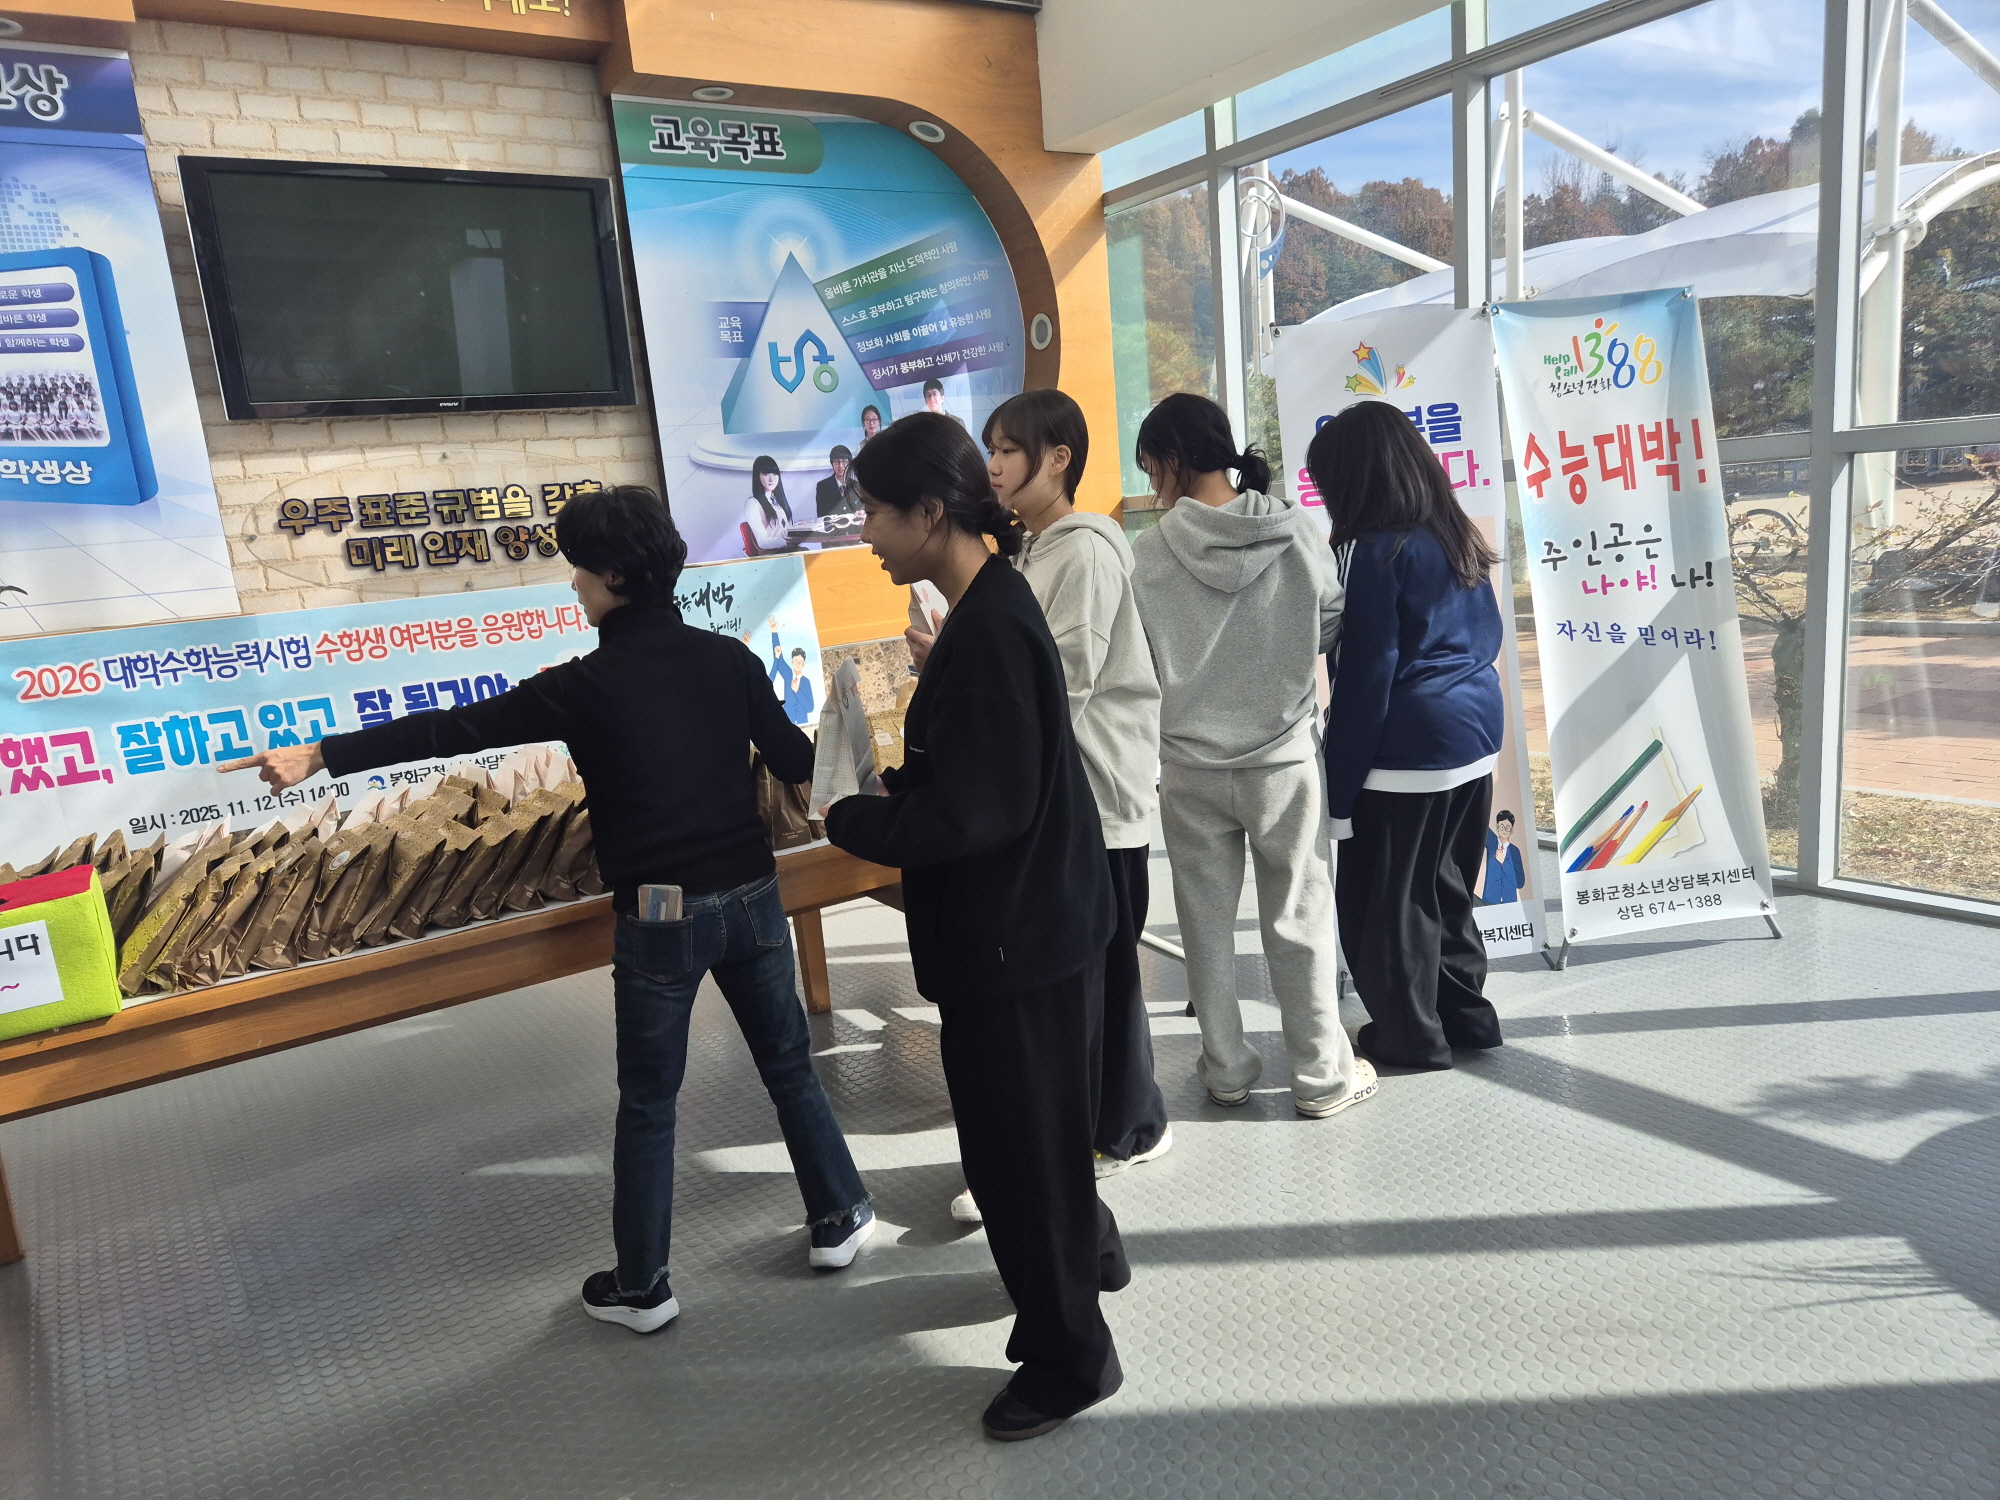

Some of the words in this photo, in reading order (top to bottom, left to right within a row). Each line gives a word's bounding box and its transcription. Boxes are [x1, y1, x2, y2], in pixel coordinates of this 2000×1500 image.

[0, 62, 69, 121] 상
[650, 115, 786, 164] 교육목표
[824, 281, 853, 300] 올바른
[853, 267, 888, 289] 가치관을
[888, 260, 906, 275] 지닌
[906, 248, 940, 269] 도덕적인
[941, 241, 958, 255] 사람
[21, 288, 42, 298] 학생
[841, 310, 868, 327] 스스로
[868, 299, 904, 318] 공부하고
[904, 287, 939, 306] 탐구하는
[939, 276, 972, 295] 창의적인
[973, 269, 989, 282] 사람
[26, 312, 47, 323] 학생
[718, 316, 742, 329] 교육
[719, 331, 744, 343] 목표
[856, 336, 884, 352] 정보화
[885, 330, 911, 345] 사회를
[911, 323, 938, 338] 이끌어
[949, 313, 974, 328] 유능한
[975, 308, 992, 320] 사람
[5, 337, 47, 348] 함께하는
[49, 337, 70, 347] 학생
[872, 365, 899, 380] 정서가
[899, 357, 935, 374] 풍부하고
[935, 351, 961, 366] 신체가
[962, 346, 987, 360] 건강한
[988, 341, 1004, 352] 사람
[1543, 353, 1571, 366] Help
[1572, 333, 1663, 389] 1388
[0, 459, 92, 485] 학생상
[1523, 418, 1707, 505] 수능대박!
[279, 496, 353, 535] 우주
[358, 491, 431, 528] 표준
[433, 484, 534, 525] 규범을
[346, 534, 419, 571] 미래
[421, 529, 491, 566] 인재
[495, 523, 558, 560] 양성
[1541, 523, 1662, 571] 주인공은
[1582, 564, 1657, 595] 나야!
[1671, 561, 1714, 589] 나!
[15, 661, 100, 700] 2026
[103, 636, 312, 689] 대학수학능력시험
[315, 626, 388, 663] 수험생
[389, 617, 478, 653] 여러분을
[481, 604, 590, 645] 응원합니다.
[1556, 619, 1627, 644] 자신을
[1637, 624, 1717, 650] 믿어라!
[0, 731, 114, 795] 했고,
[116, 709, 254, 775] 잘하고
[353, 688, 393, 731] 잘
[128, 815, 167, 834] 일시
[179, 803, 223, 827] 2025.
[228, 799, 250, 817] 11.
[1575, 866, 1757, 906] 봉화군청소년상담복지센터
[1616, 903, 1646, 921] 상담
[1649, 893, 1723, 915] 674-1388
[1479, 922, 1535, 944] 복지센터
